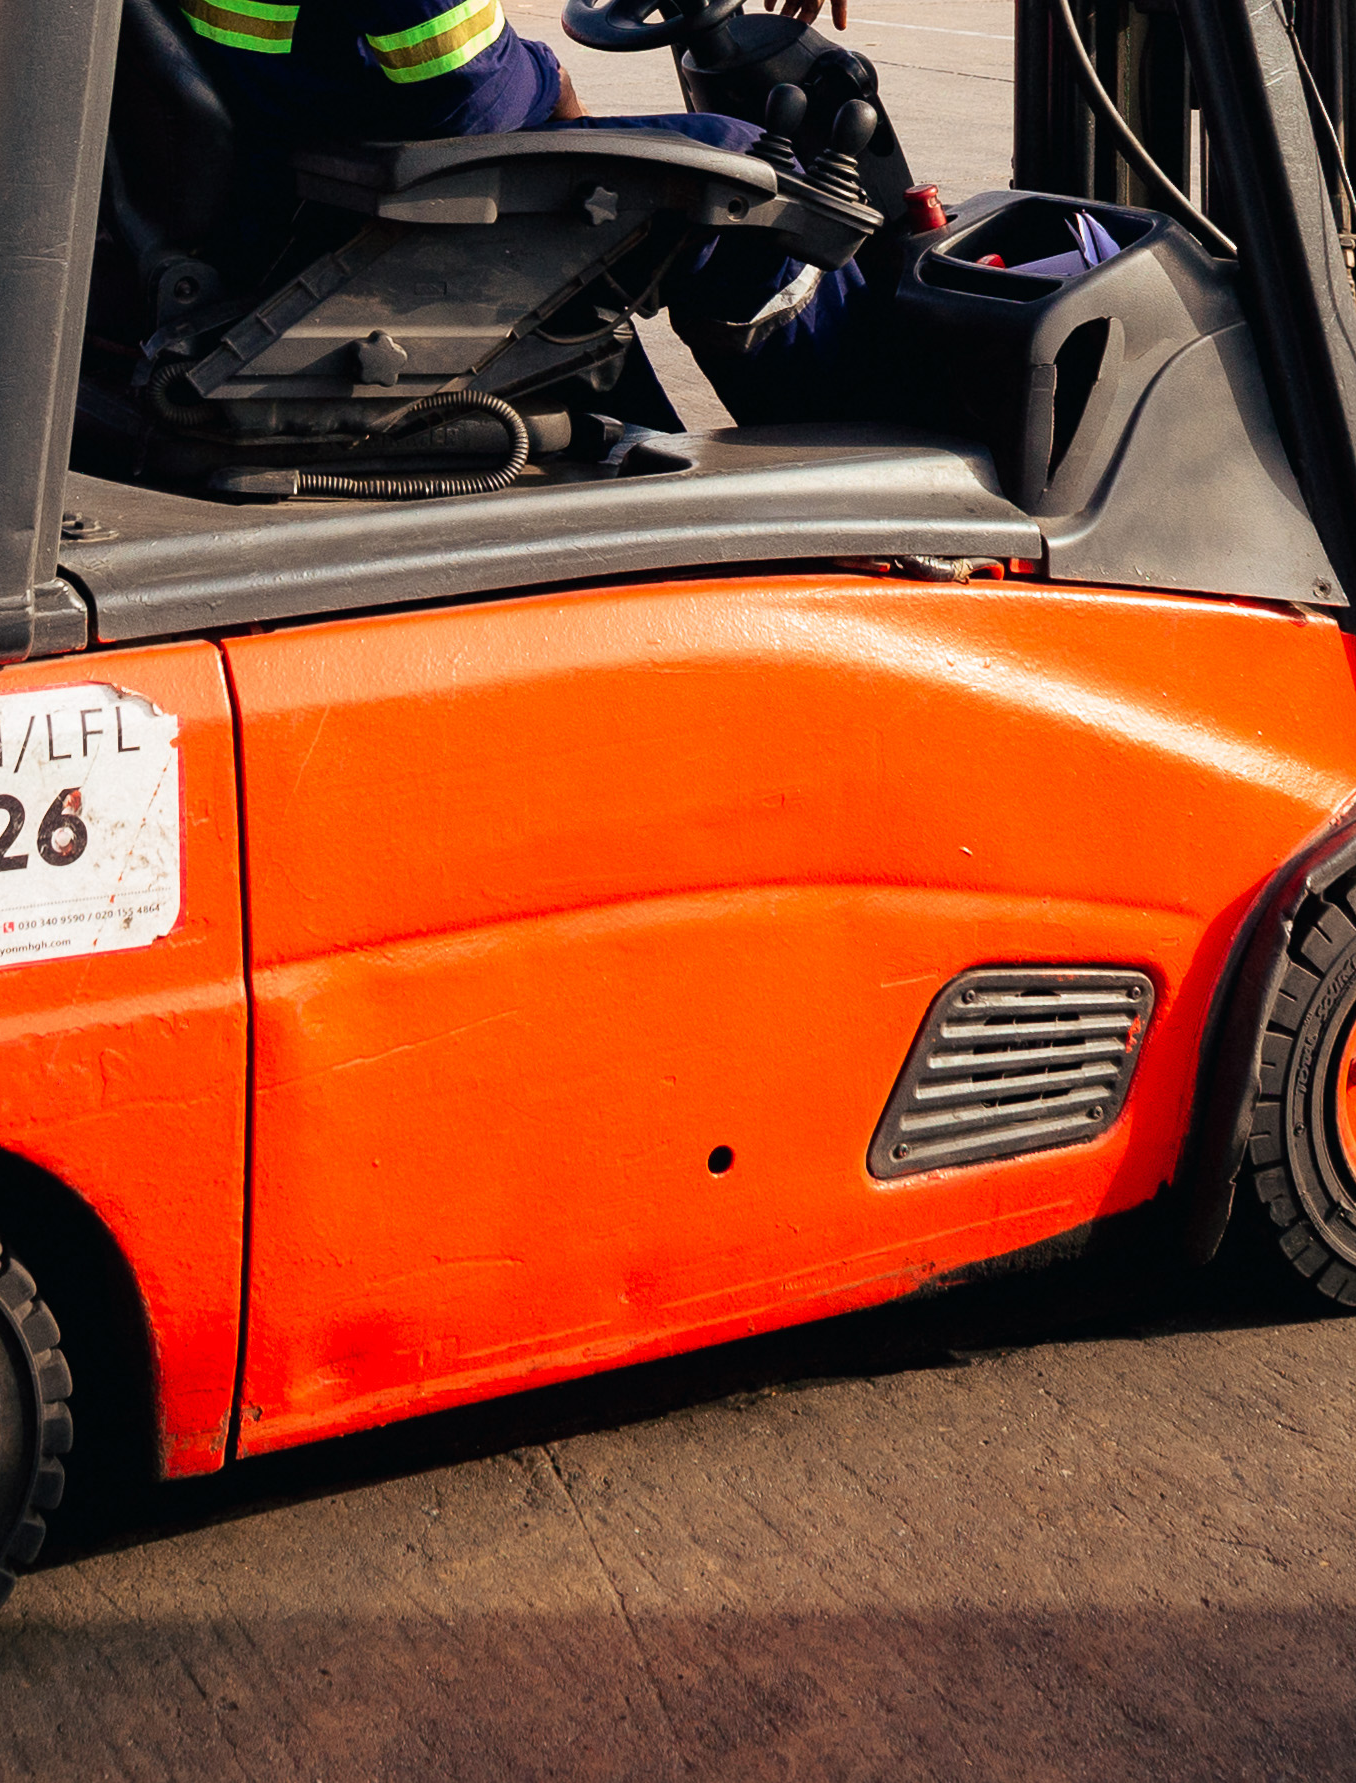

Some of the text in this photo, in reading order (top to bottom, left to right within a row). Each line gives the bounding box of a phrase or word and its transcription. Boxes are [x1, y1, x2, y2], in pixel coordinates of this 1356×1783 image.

[18, 920, 36, 931] 030
[40, 917, 57, 928] 340
[60, 914, 85, 925] 9590
[95, 910, 113, 921] 020
